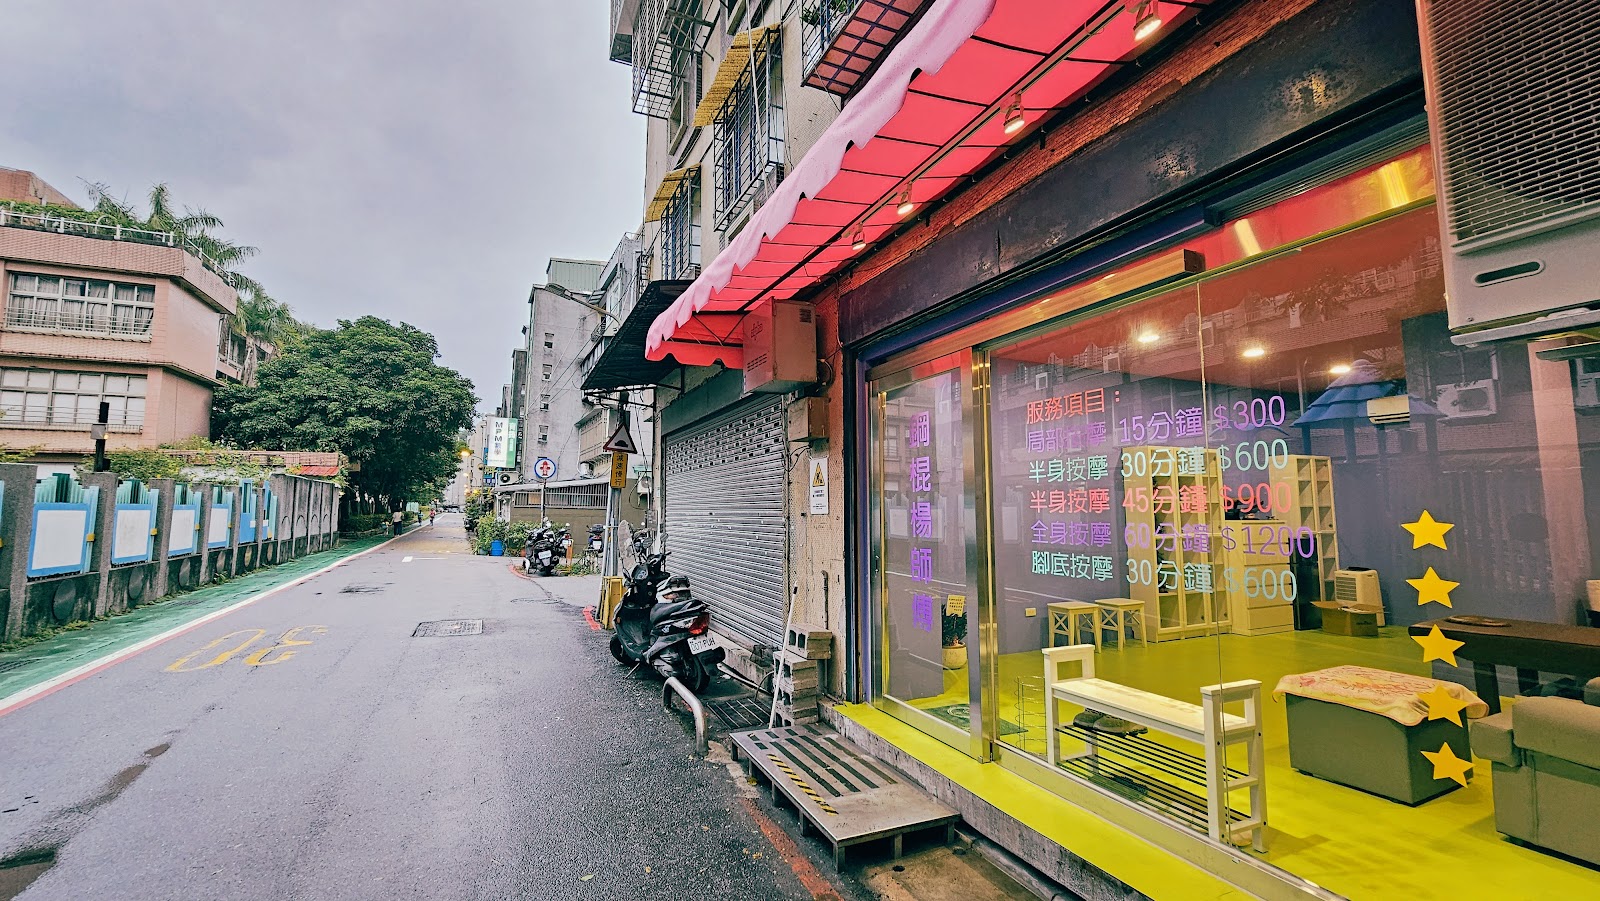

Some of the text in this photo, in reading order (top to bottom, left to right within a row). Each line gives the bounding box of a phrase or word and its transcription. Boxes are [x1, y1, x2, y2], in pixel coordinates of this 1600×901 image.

[1119, 406, 1204, 442] 15分鐘
[1214, 395, 1286, 431] $300
[615, 454, 624, 486] 減速慢行
[1028, 439, 1288, 483] 半身按摩 30分鐘 $600
[1029, 481, 1292, 514] 半身按摩 45分鐘 $900
[1030, 519, 1315, 559] 全身按摩 60分鐘 $1200
[1031, 550, 1298, 602] 腳底按摩 30分鐘 $600
[164, 624, 329, 672] 30
